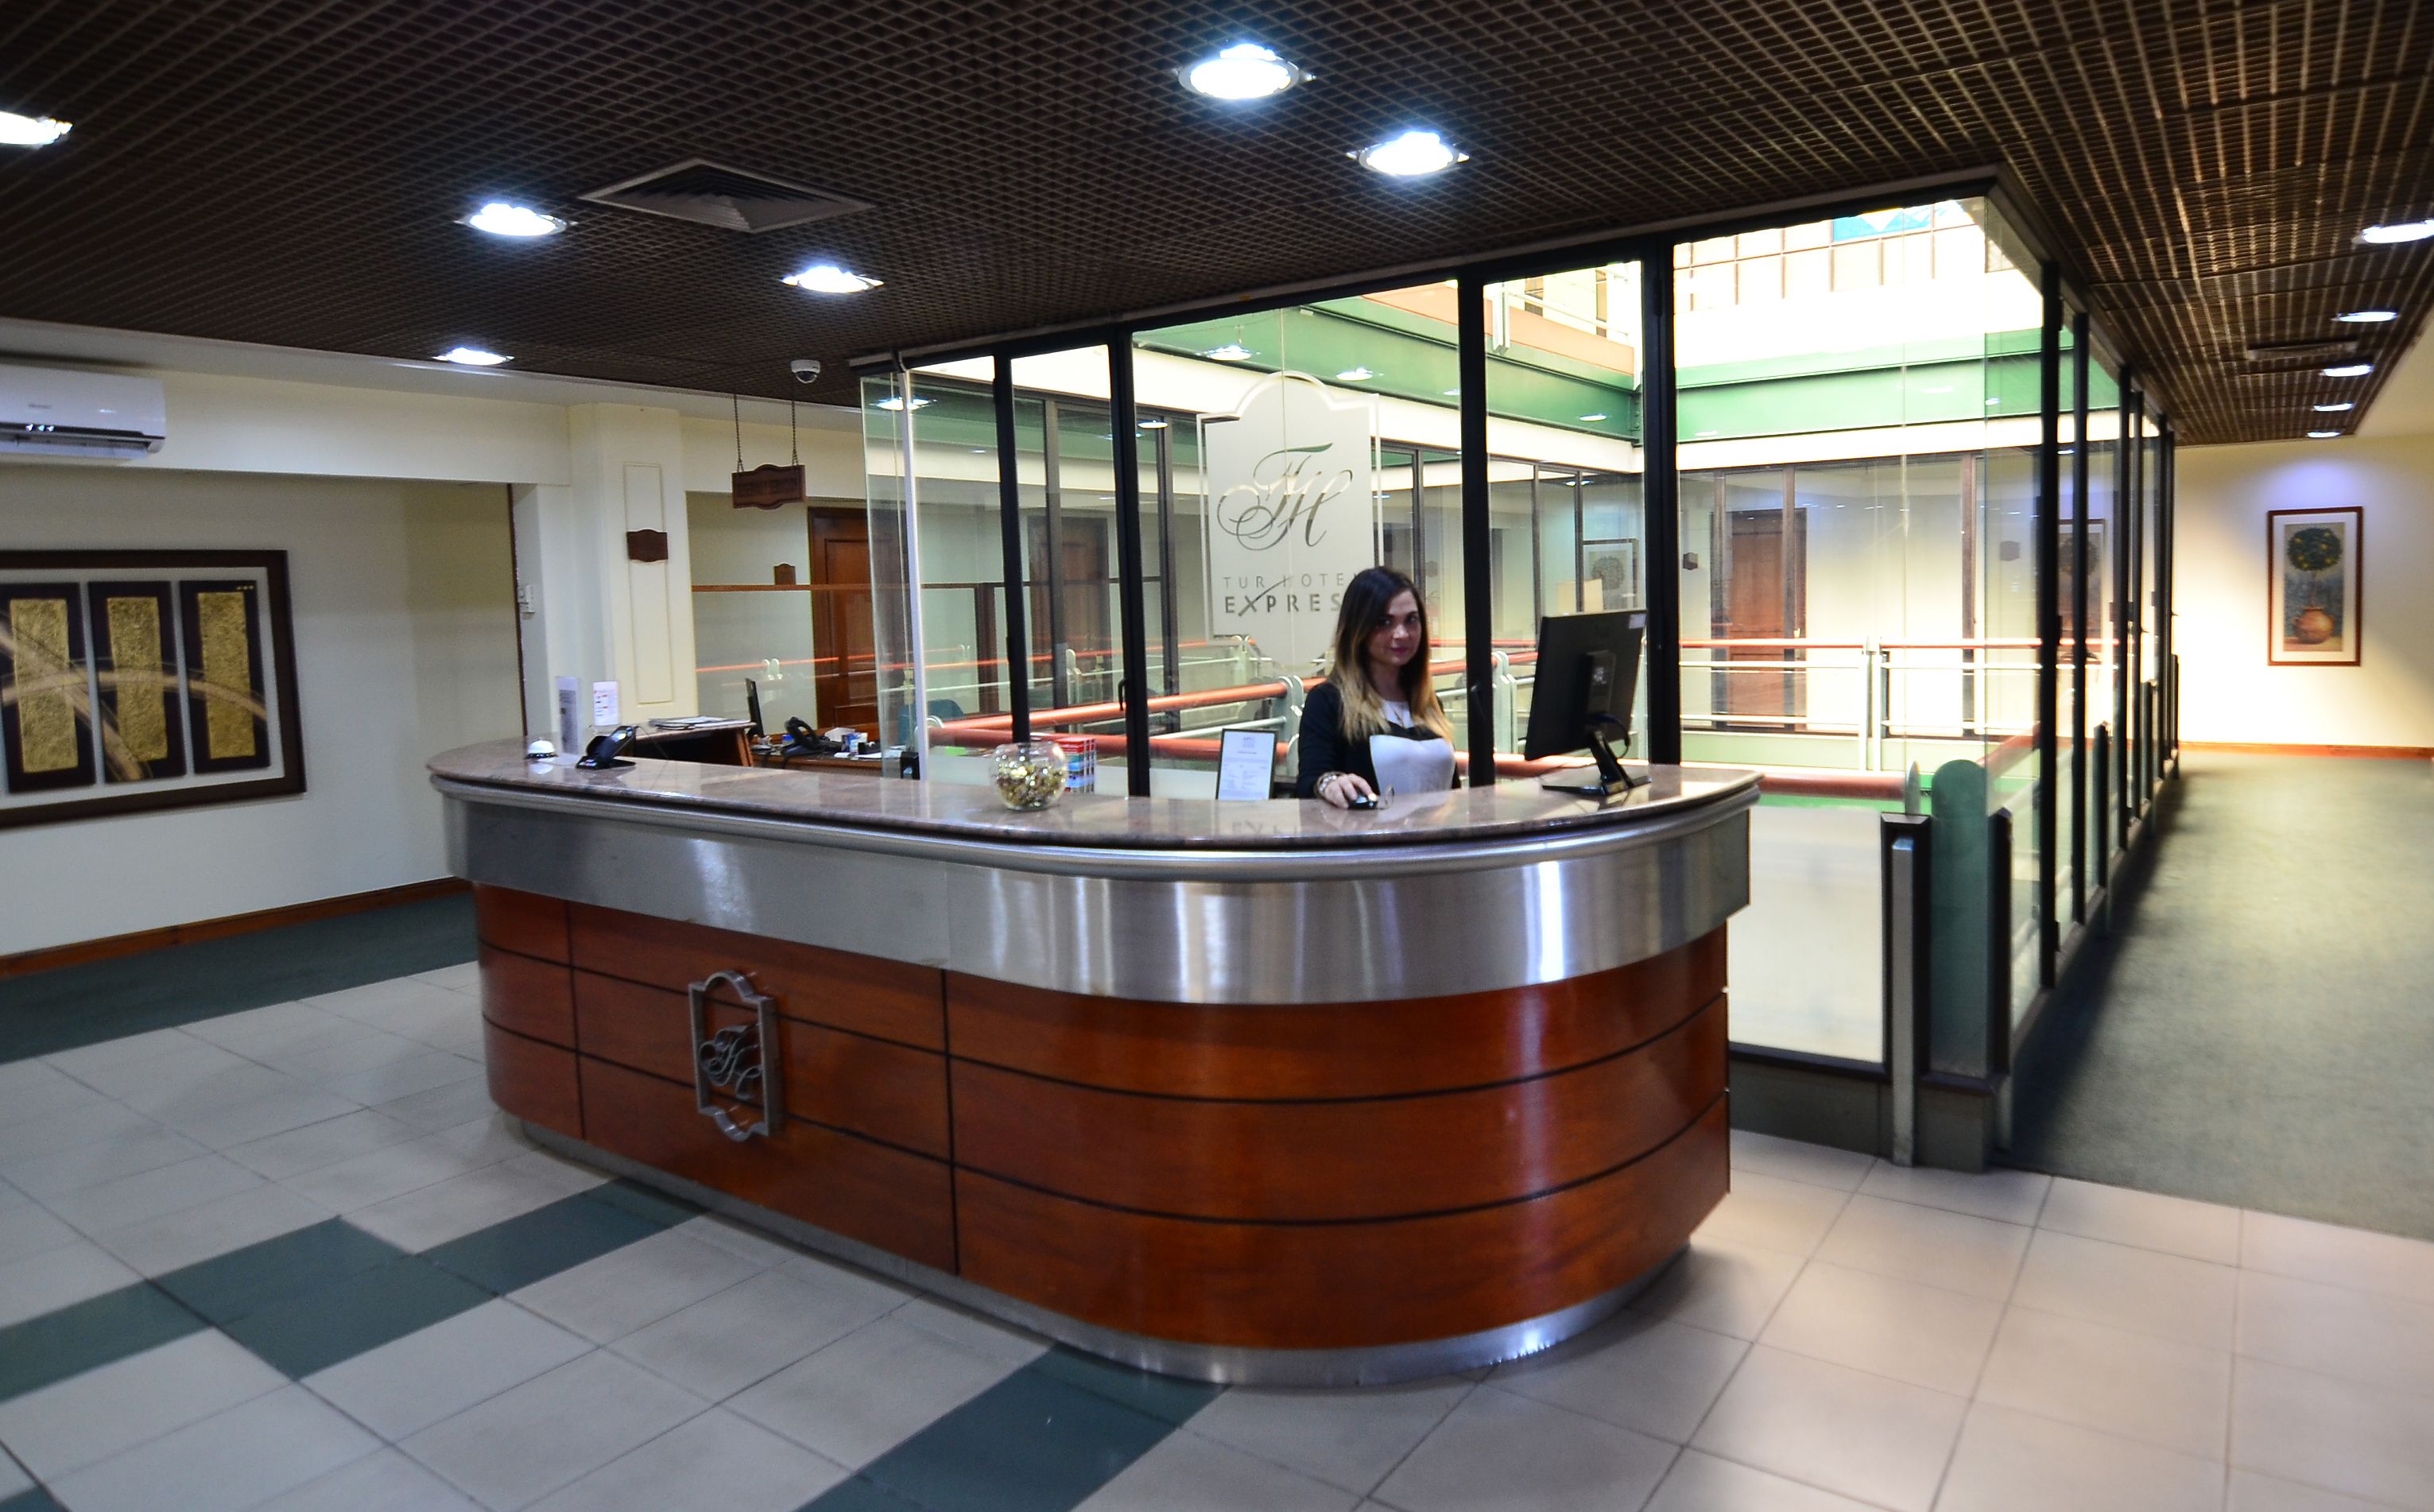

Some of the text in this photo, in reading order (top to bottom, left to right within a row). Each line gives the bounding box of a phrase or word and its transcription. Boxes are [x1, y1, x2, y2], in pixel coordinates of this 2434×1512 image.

[1223, 572, 1357, 589] TUR HOTE
[1224, 592, 1341, 617] EXPRES
